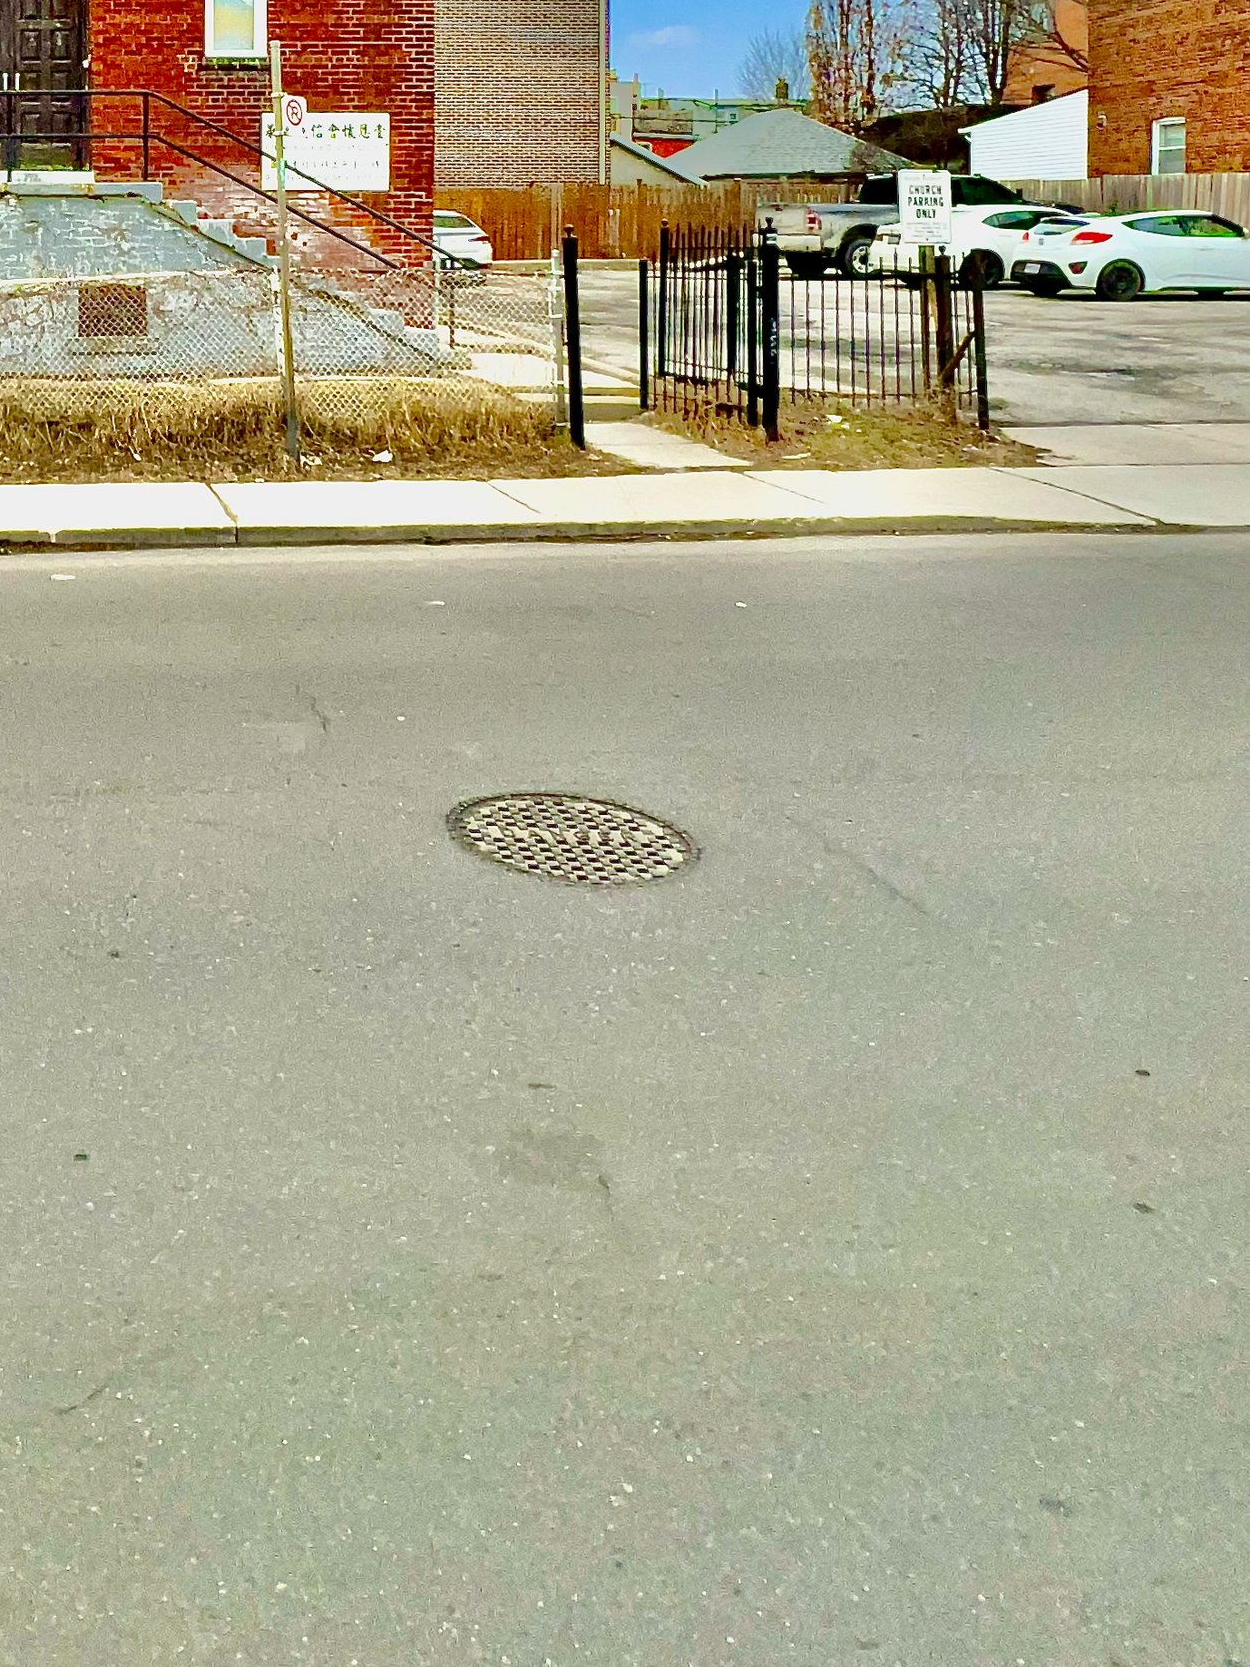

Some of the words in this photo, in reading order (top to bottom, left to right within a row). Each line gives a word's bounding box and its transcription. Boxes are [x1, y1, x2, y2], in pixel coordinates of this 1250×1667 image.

[909, 185, 942, 194] CHURCH
[908, 197, 944, 206] PARKING
[916, 209, 936, 219] ONLY
